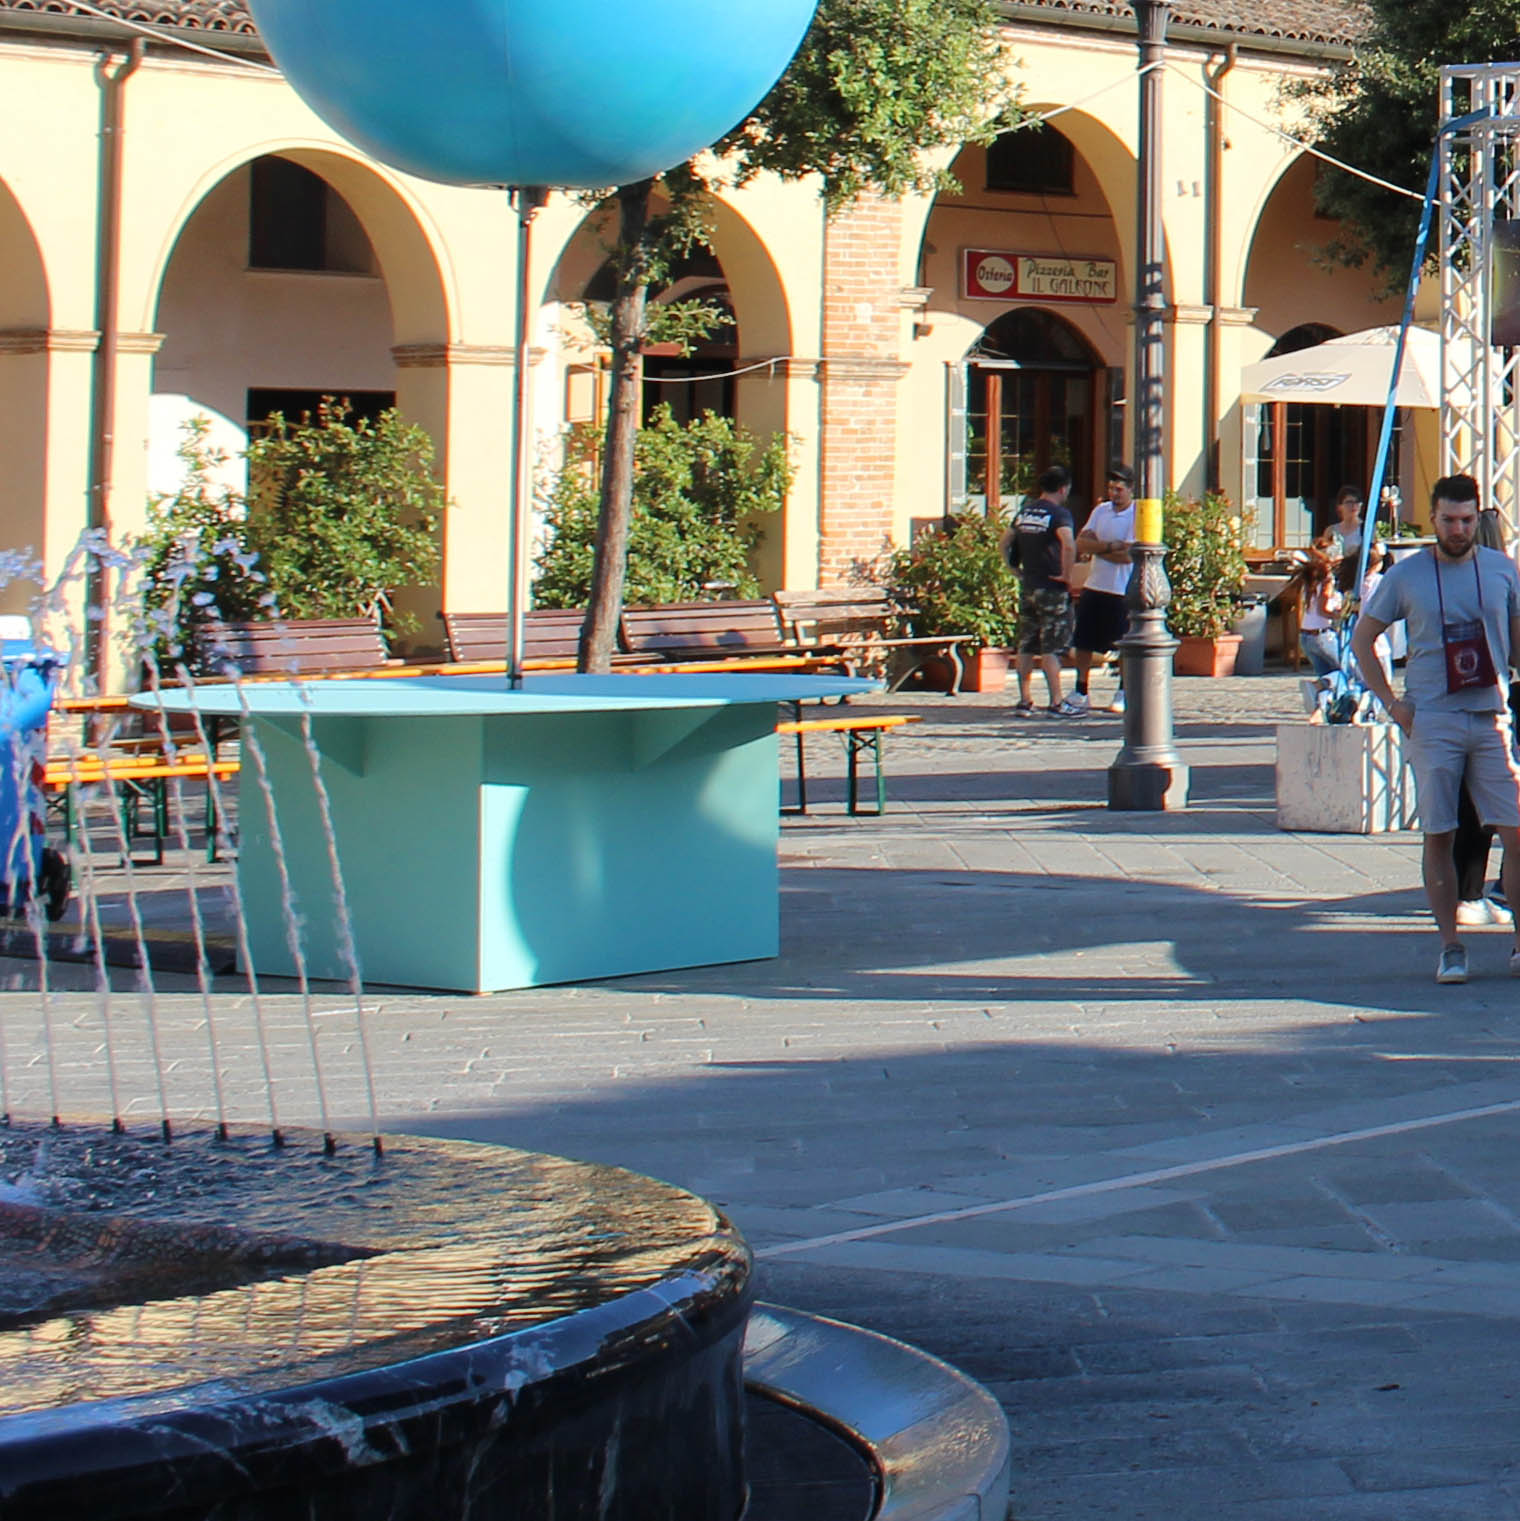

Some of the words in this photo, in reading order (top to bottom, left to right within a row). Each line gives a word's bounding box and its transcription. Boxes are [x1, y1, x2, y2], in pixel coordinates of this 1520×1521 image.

[978, 264, 1012, 282] Osteria
[1086, 262, 1109, 278] Bar
[1031, 277, 1045, 293] IL
